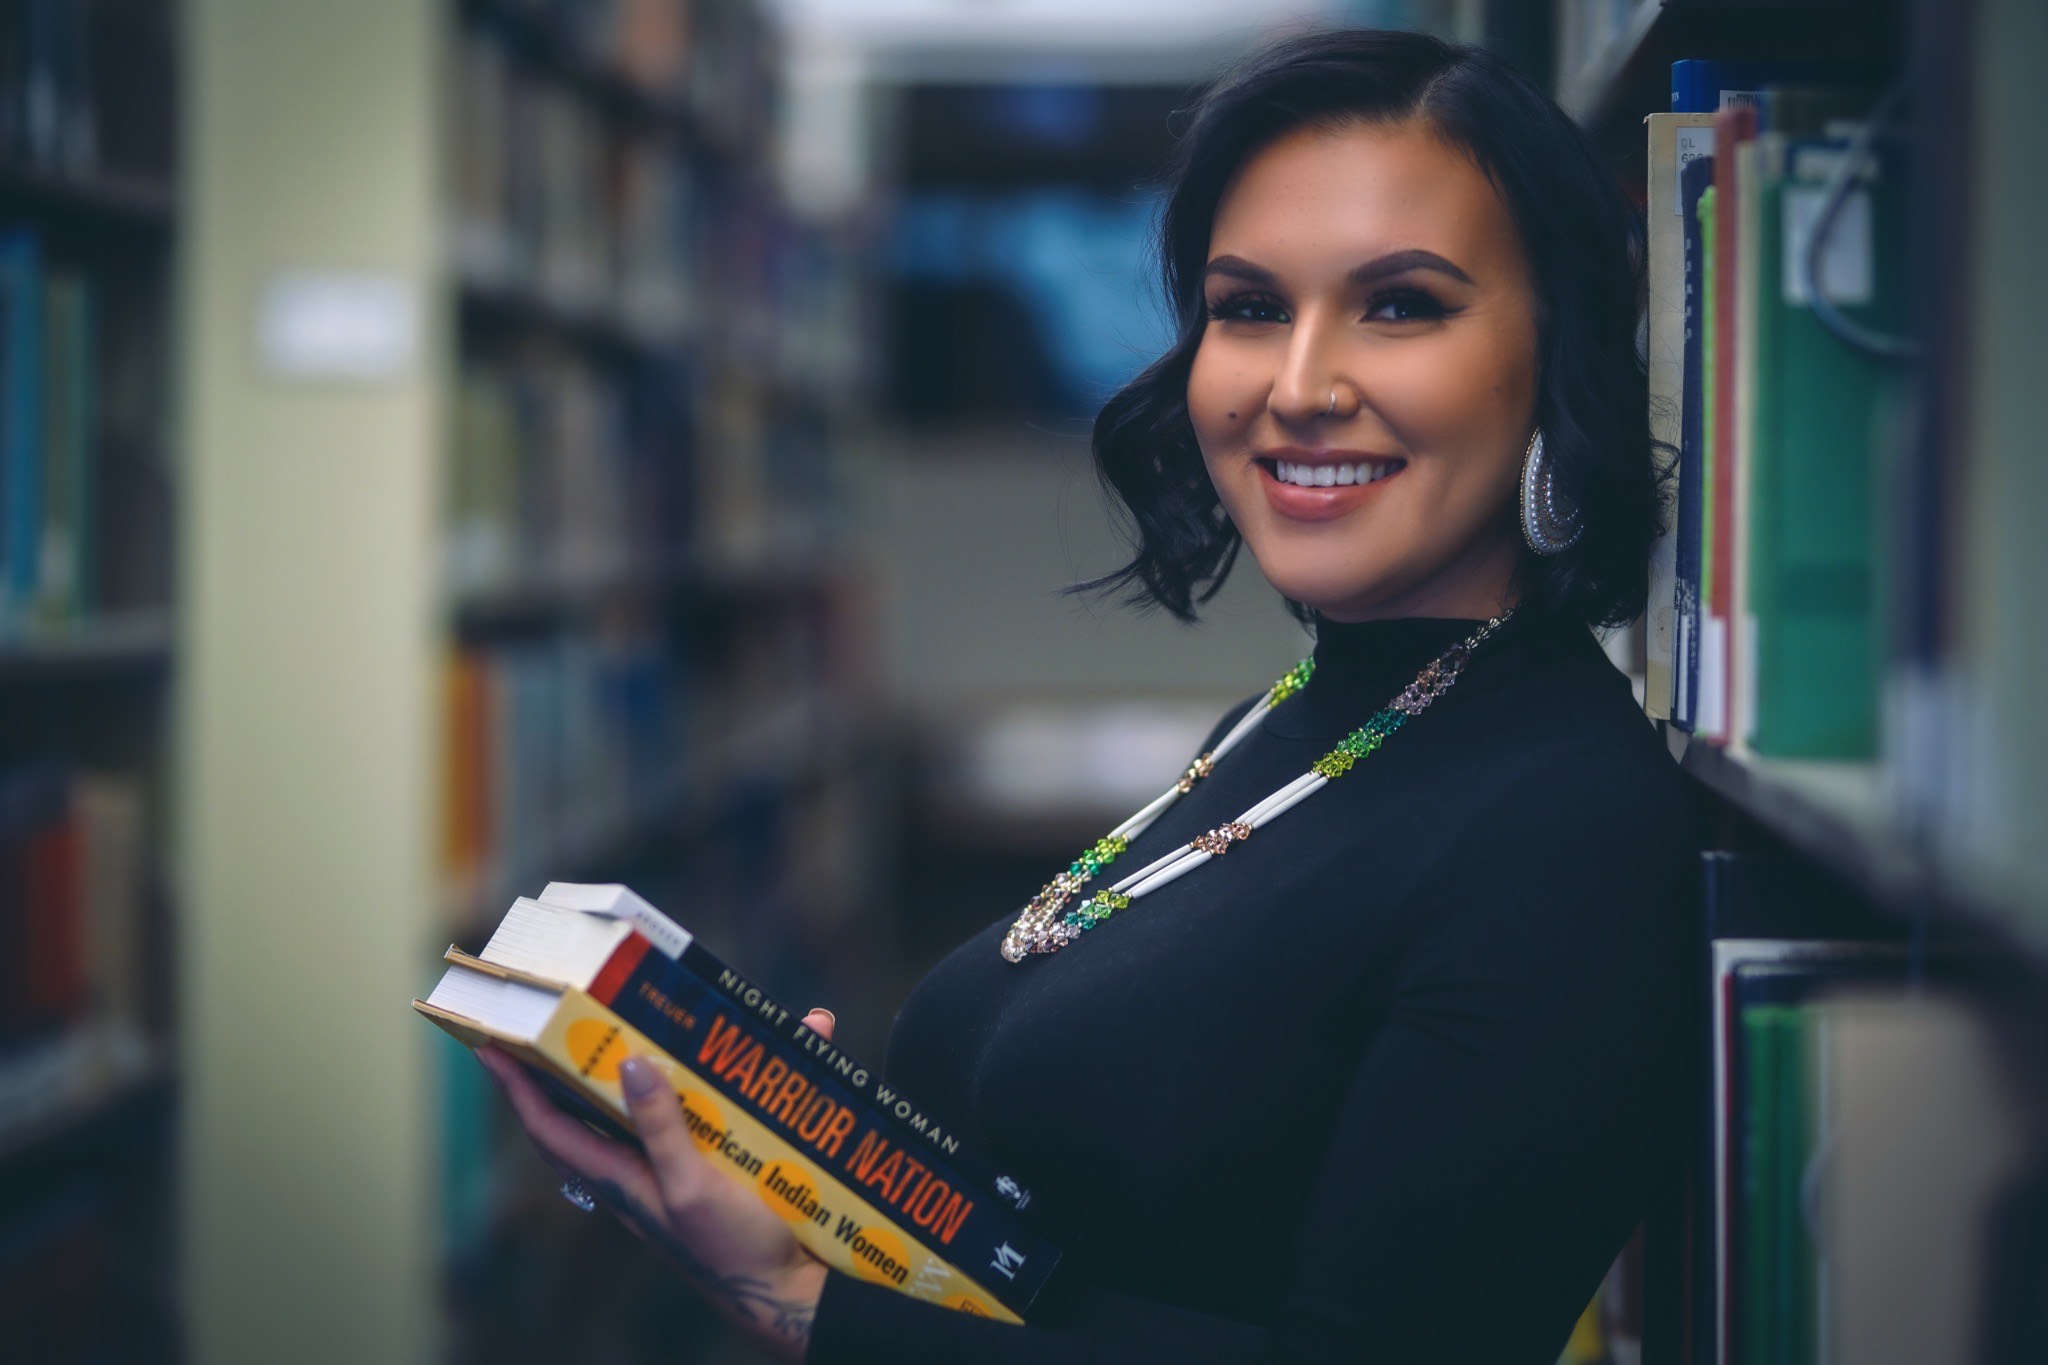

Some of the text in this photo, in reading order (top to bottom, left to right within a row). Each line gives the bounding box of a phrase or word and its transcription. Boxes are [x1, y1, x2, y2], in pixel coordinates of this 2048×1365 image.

[638, 981, 697, 1031] TREUER
[717, 969, 960, 1154] NIGHT FLYING WOMAN
[697, 1014, 974, 1245] WARRIOR NATION
[764, 1165, 832, 1228] Indian
[834, 1215, 909, 1284] Women
